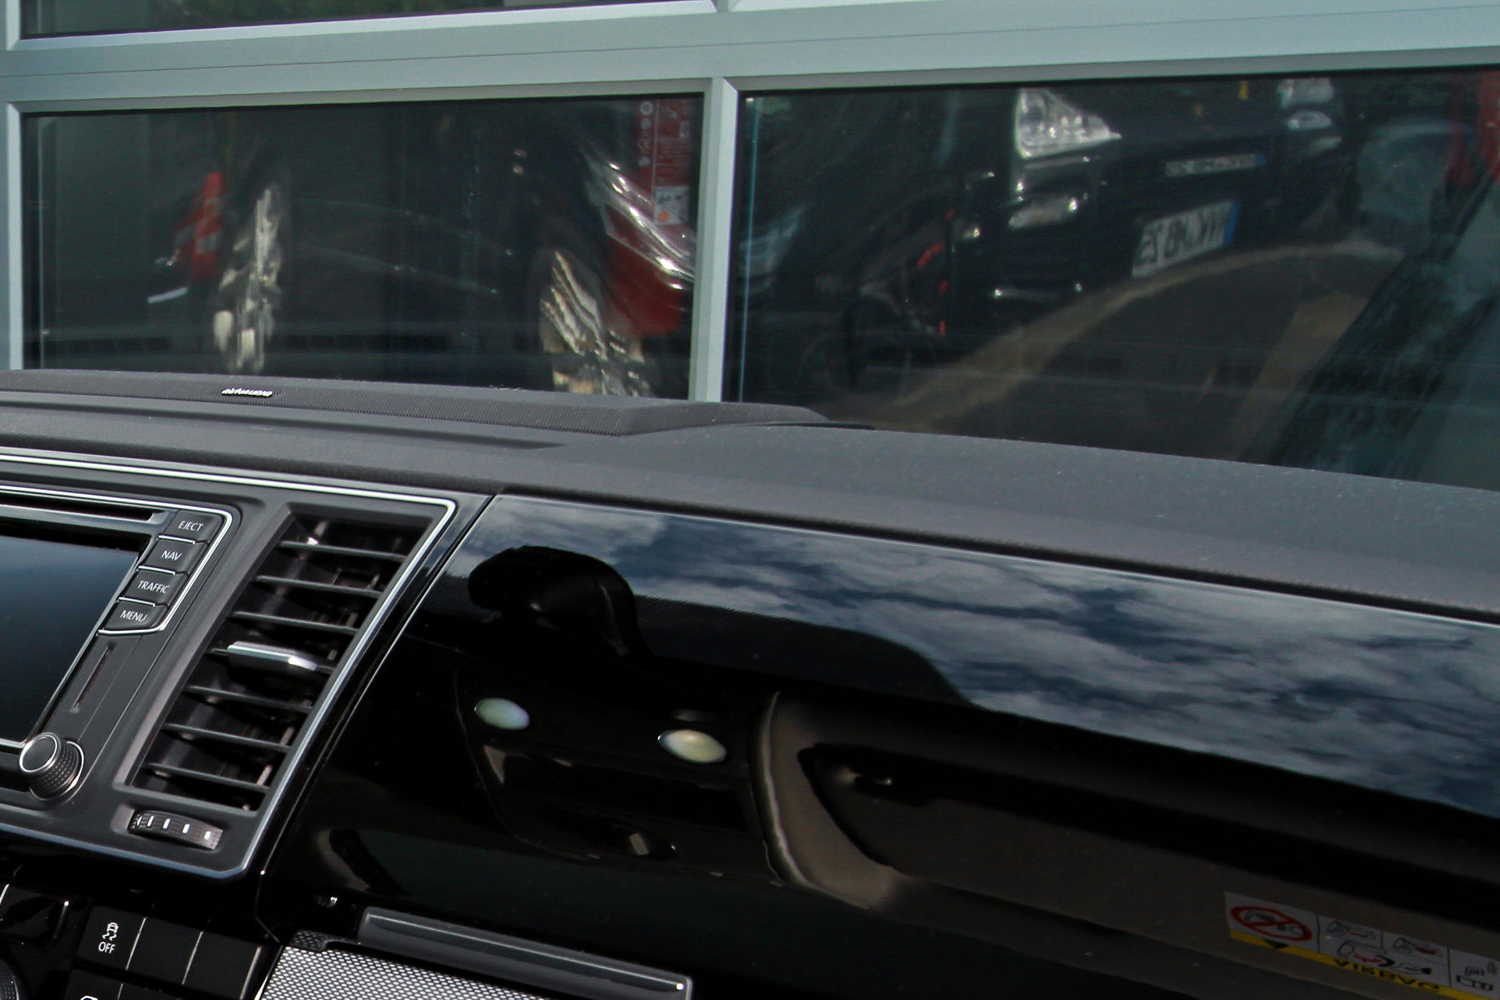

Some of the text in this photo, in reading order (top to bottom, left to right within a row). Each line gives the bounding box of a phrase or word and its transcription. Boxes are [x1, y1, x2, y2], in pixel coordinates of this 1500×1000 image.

[177, 520, 204, 532] EJECT
[161, 550, 182, 561] NAV
[137, 580, 171, 594] TRAFFIC
[120, 609, 148, 622] MENU
[98, 941, 116, 954] OFF
